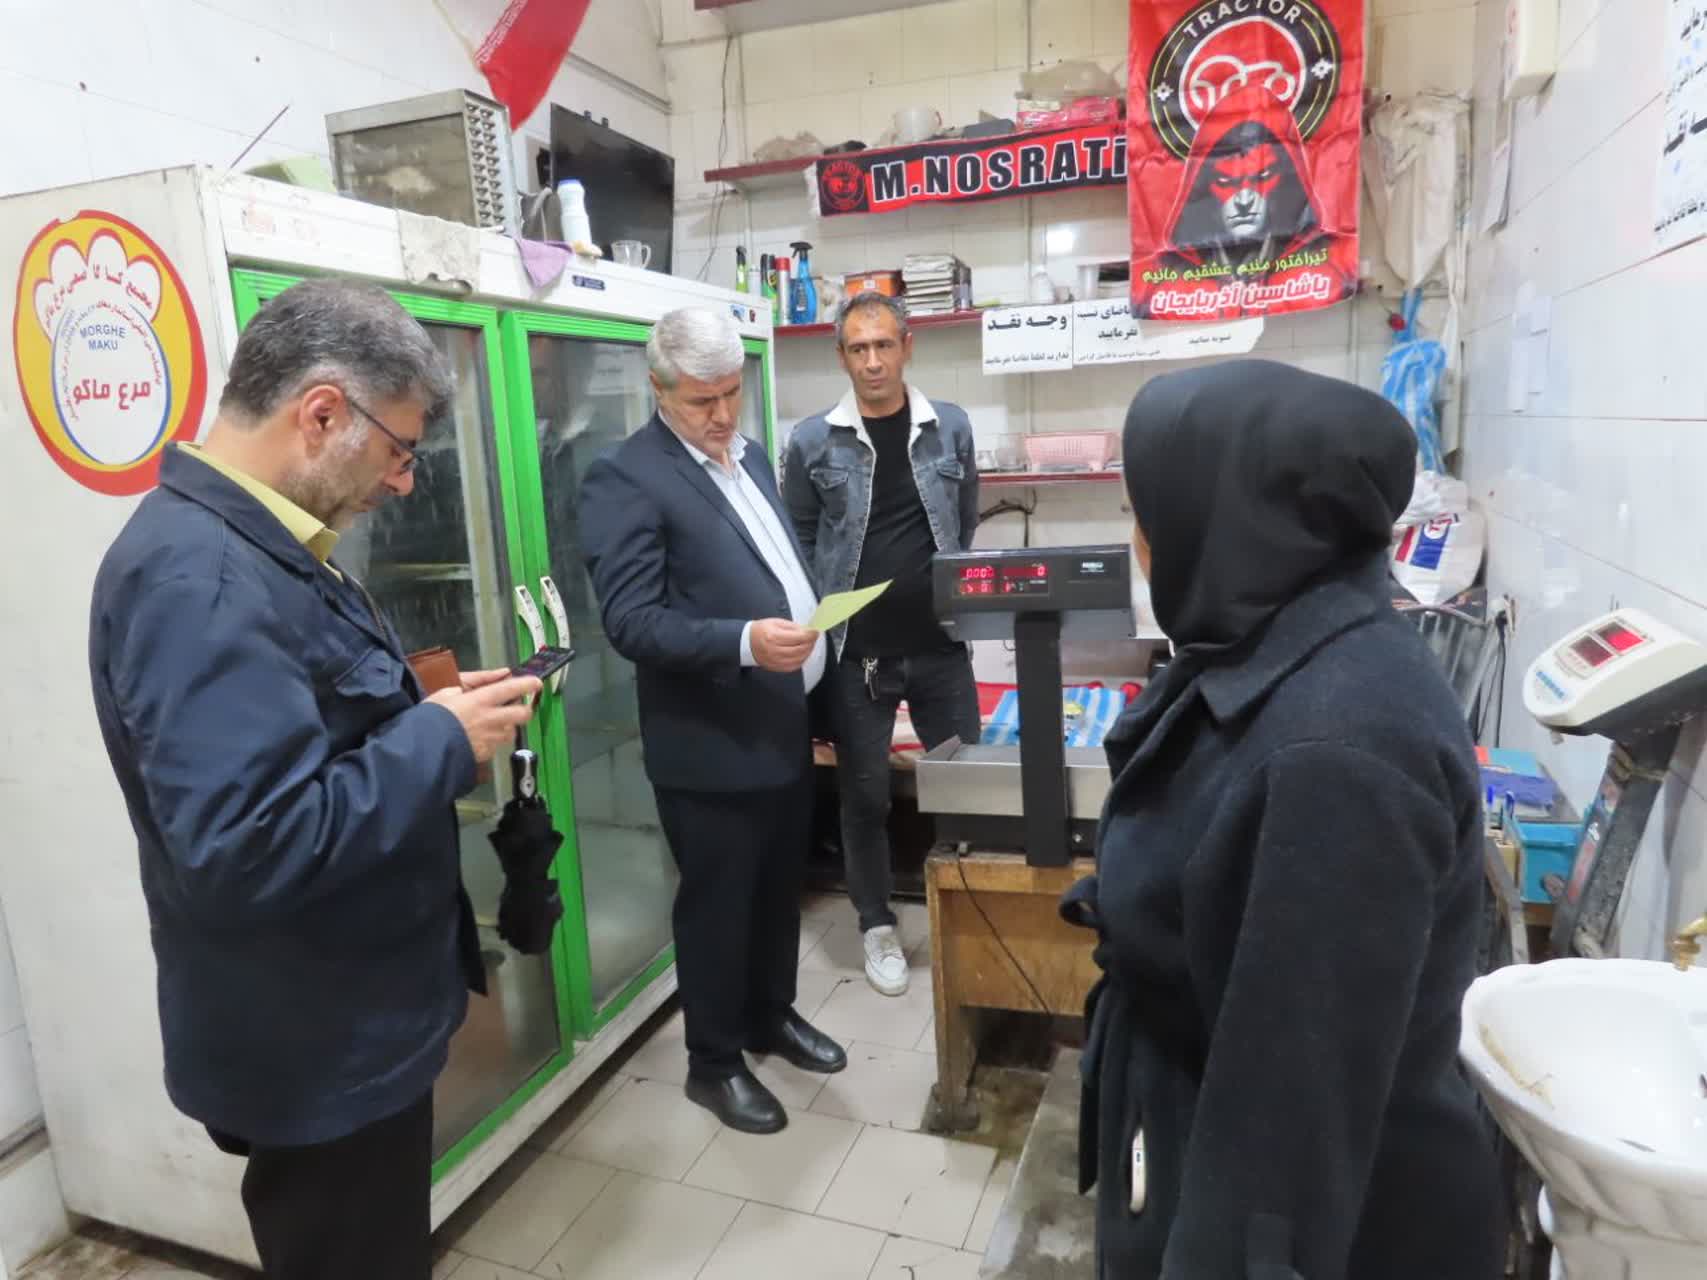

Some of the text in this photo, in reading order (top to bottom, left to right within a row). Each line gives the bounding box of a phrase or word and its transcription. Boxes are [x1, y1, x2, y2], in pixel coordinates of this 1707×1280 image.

[871, 136, 1127, 203] M.NOSRATi
[1151, 272, 1331, 314] یاشاسین آذربایجان
[79, 323, 127, 339] MORGHE
[987, 313, 1068, 330] وجه نقد
[88, 339, 119, 351] MAKU
[73, 379, 110, 405] ماکو
